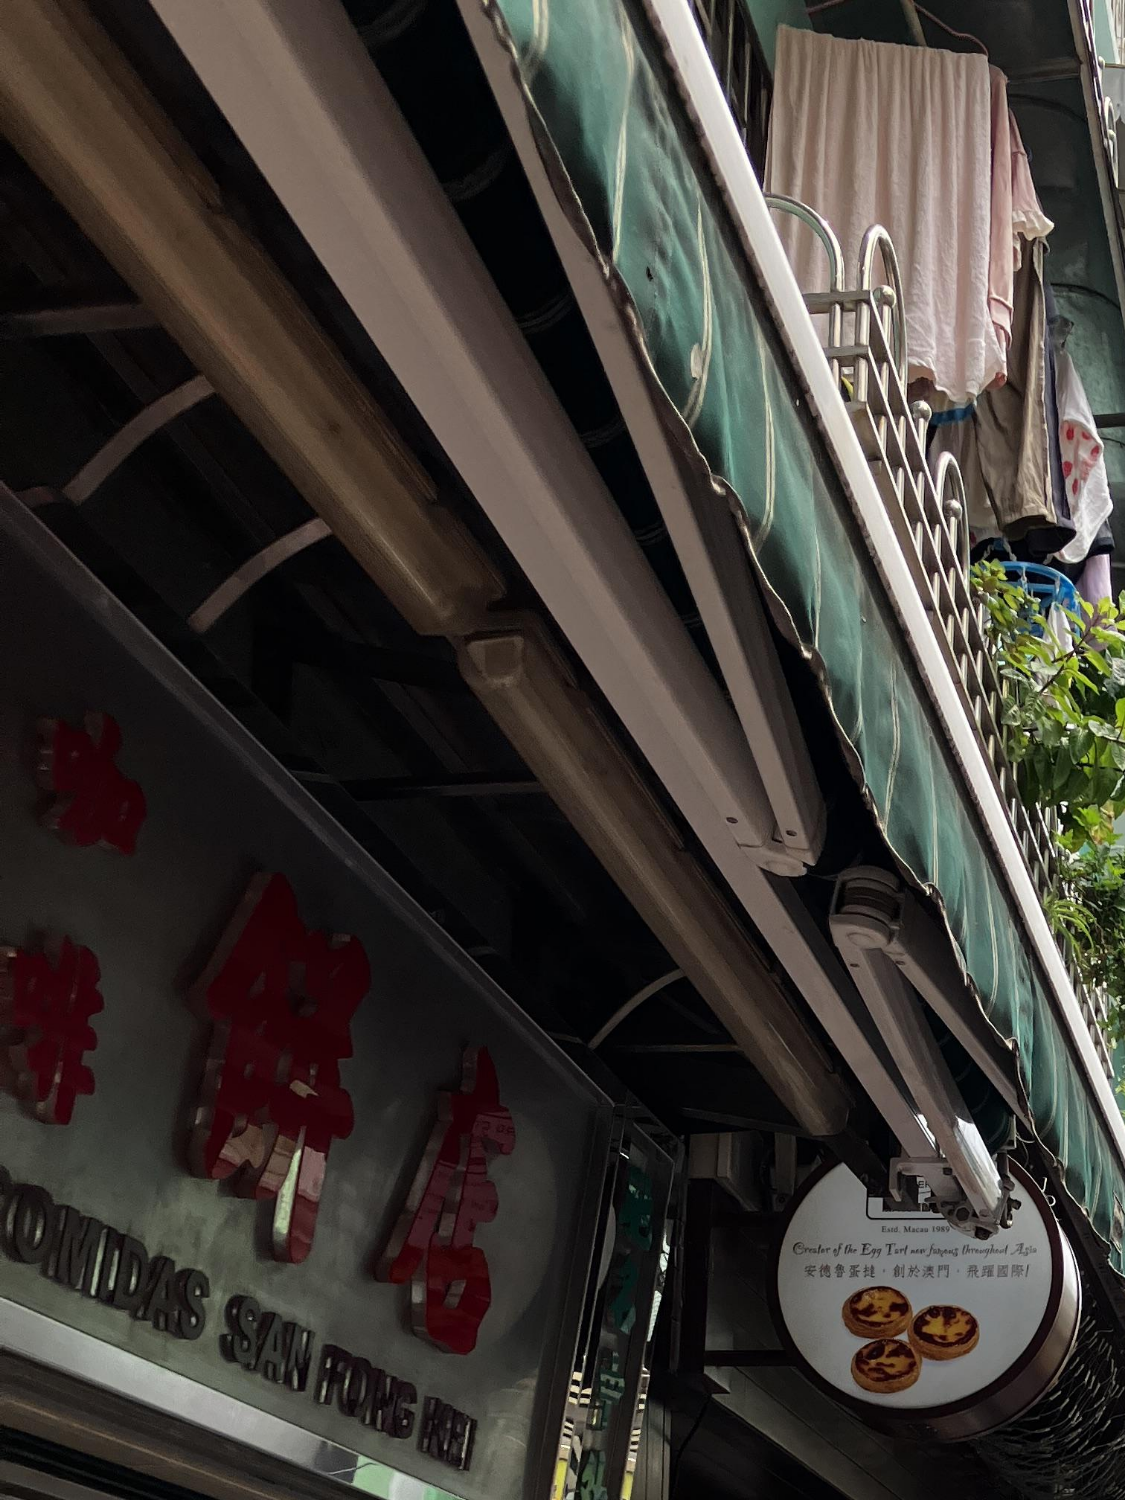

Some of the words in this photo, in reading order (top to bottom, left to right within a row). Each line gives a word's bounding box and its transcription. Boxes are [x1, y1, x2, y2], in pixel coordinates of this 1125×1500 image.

[190, 872, 516, 1354] 餅店
[0, 1172, 210, 1341] OMIDAS
[219, 1295, 315, 1392] SAN
[792, 1242, 831, 1256] Creator
[833, 1243, 843, 1257] of
[844, 1243, 858, 1255] the
[859, 1242, 882, 1259] Egg
[885, 1243, 909, 1255] Tart
[926, 1243, 959, 1258] famous
[962, 1244, 1009, 1259] throughout
[1010, 1242, 1038, 1257] Asia
[904, 1226, 929, 1234] Macau
[932, 1226, 950, 1234] 1989
